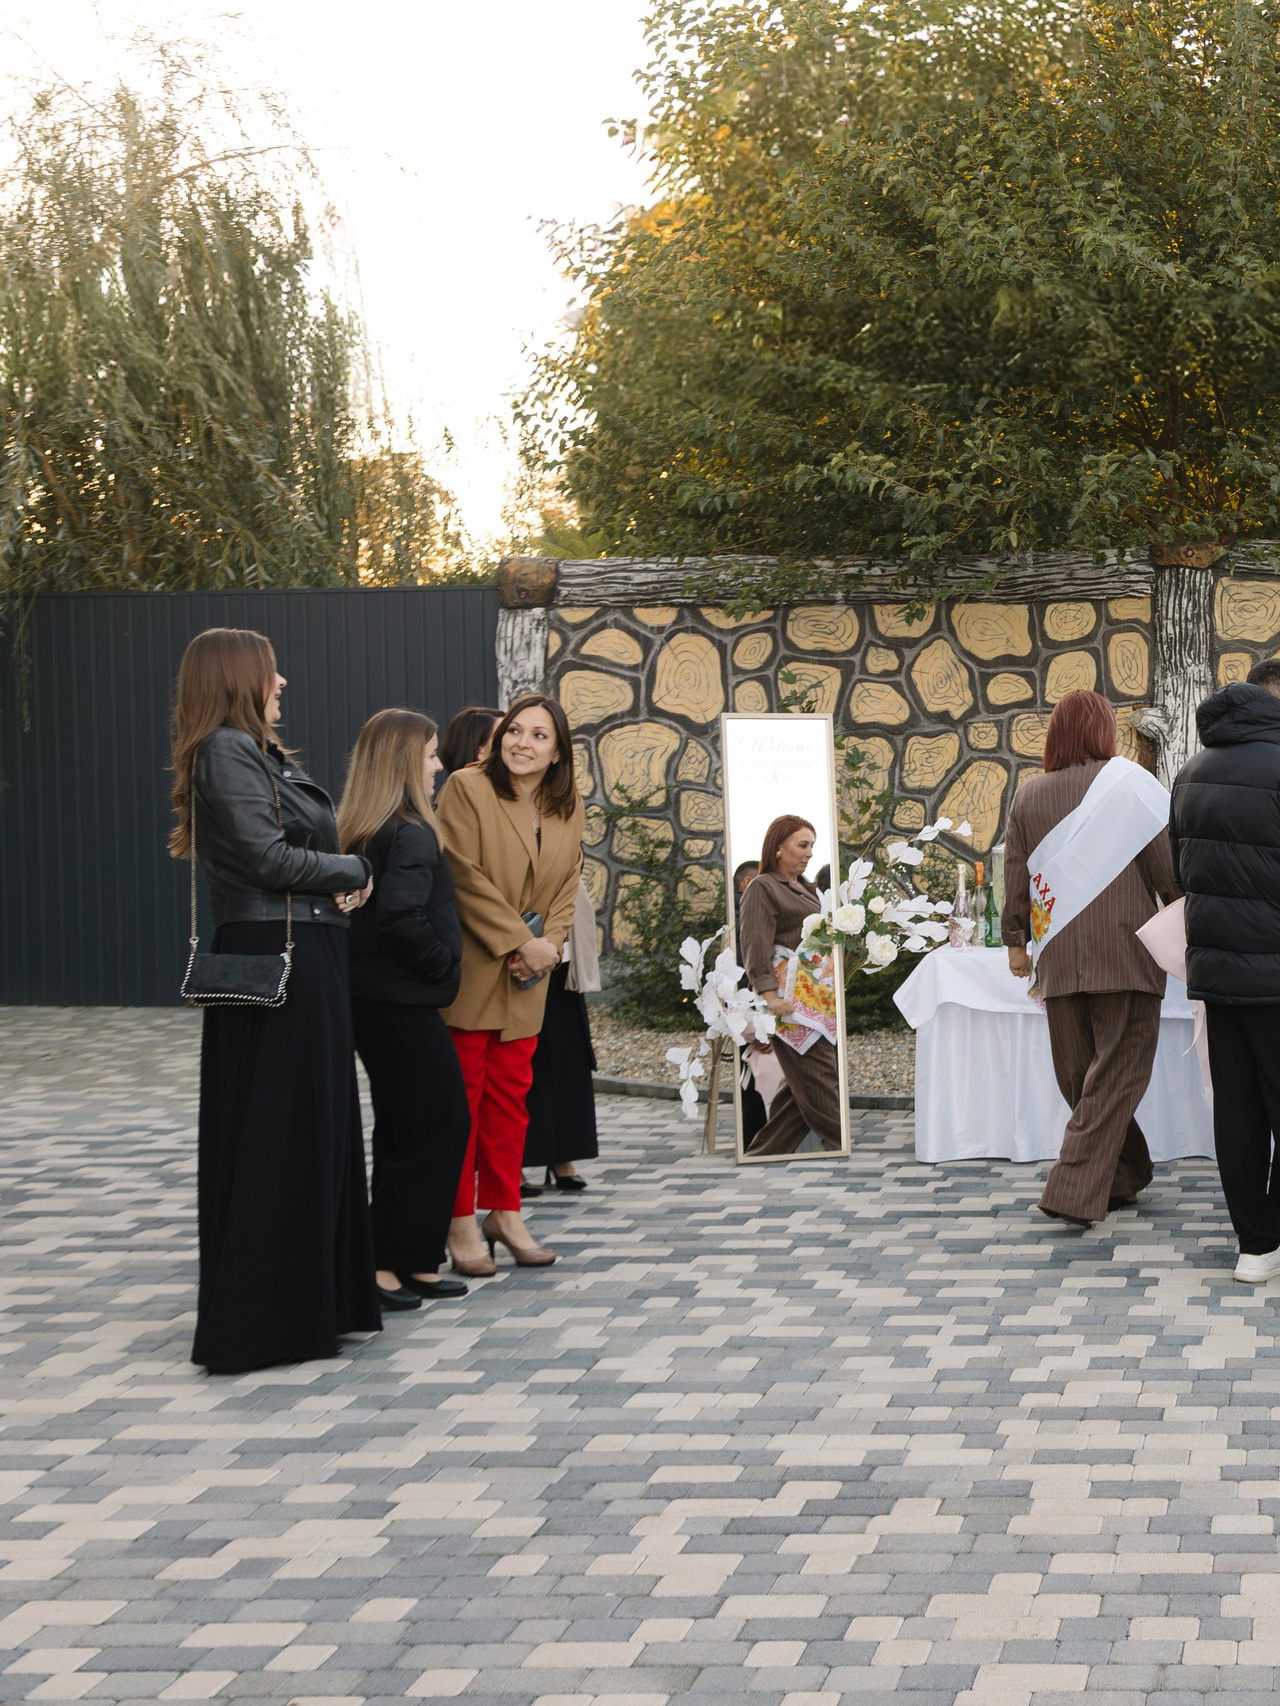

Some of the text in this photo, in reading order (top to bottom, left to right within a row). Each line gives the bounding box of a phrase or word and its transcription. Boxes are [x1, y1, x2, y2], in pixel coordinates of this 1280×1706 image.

[737, 734, 813, 753] Welcome
[739, 758, 813, 770] to our wedding
